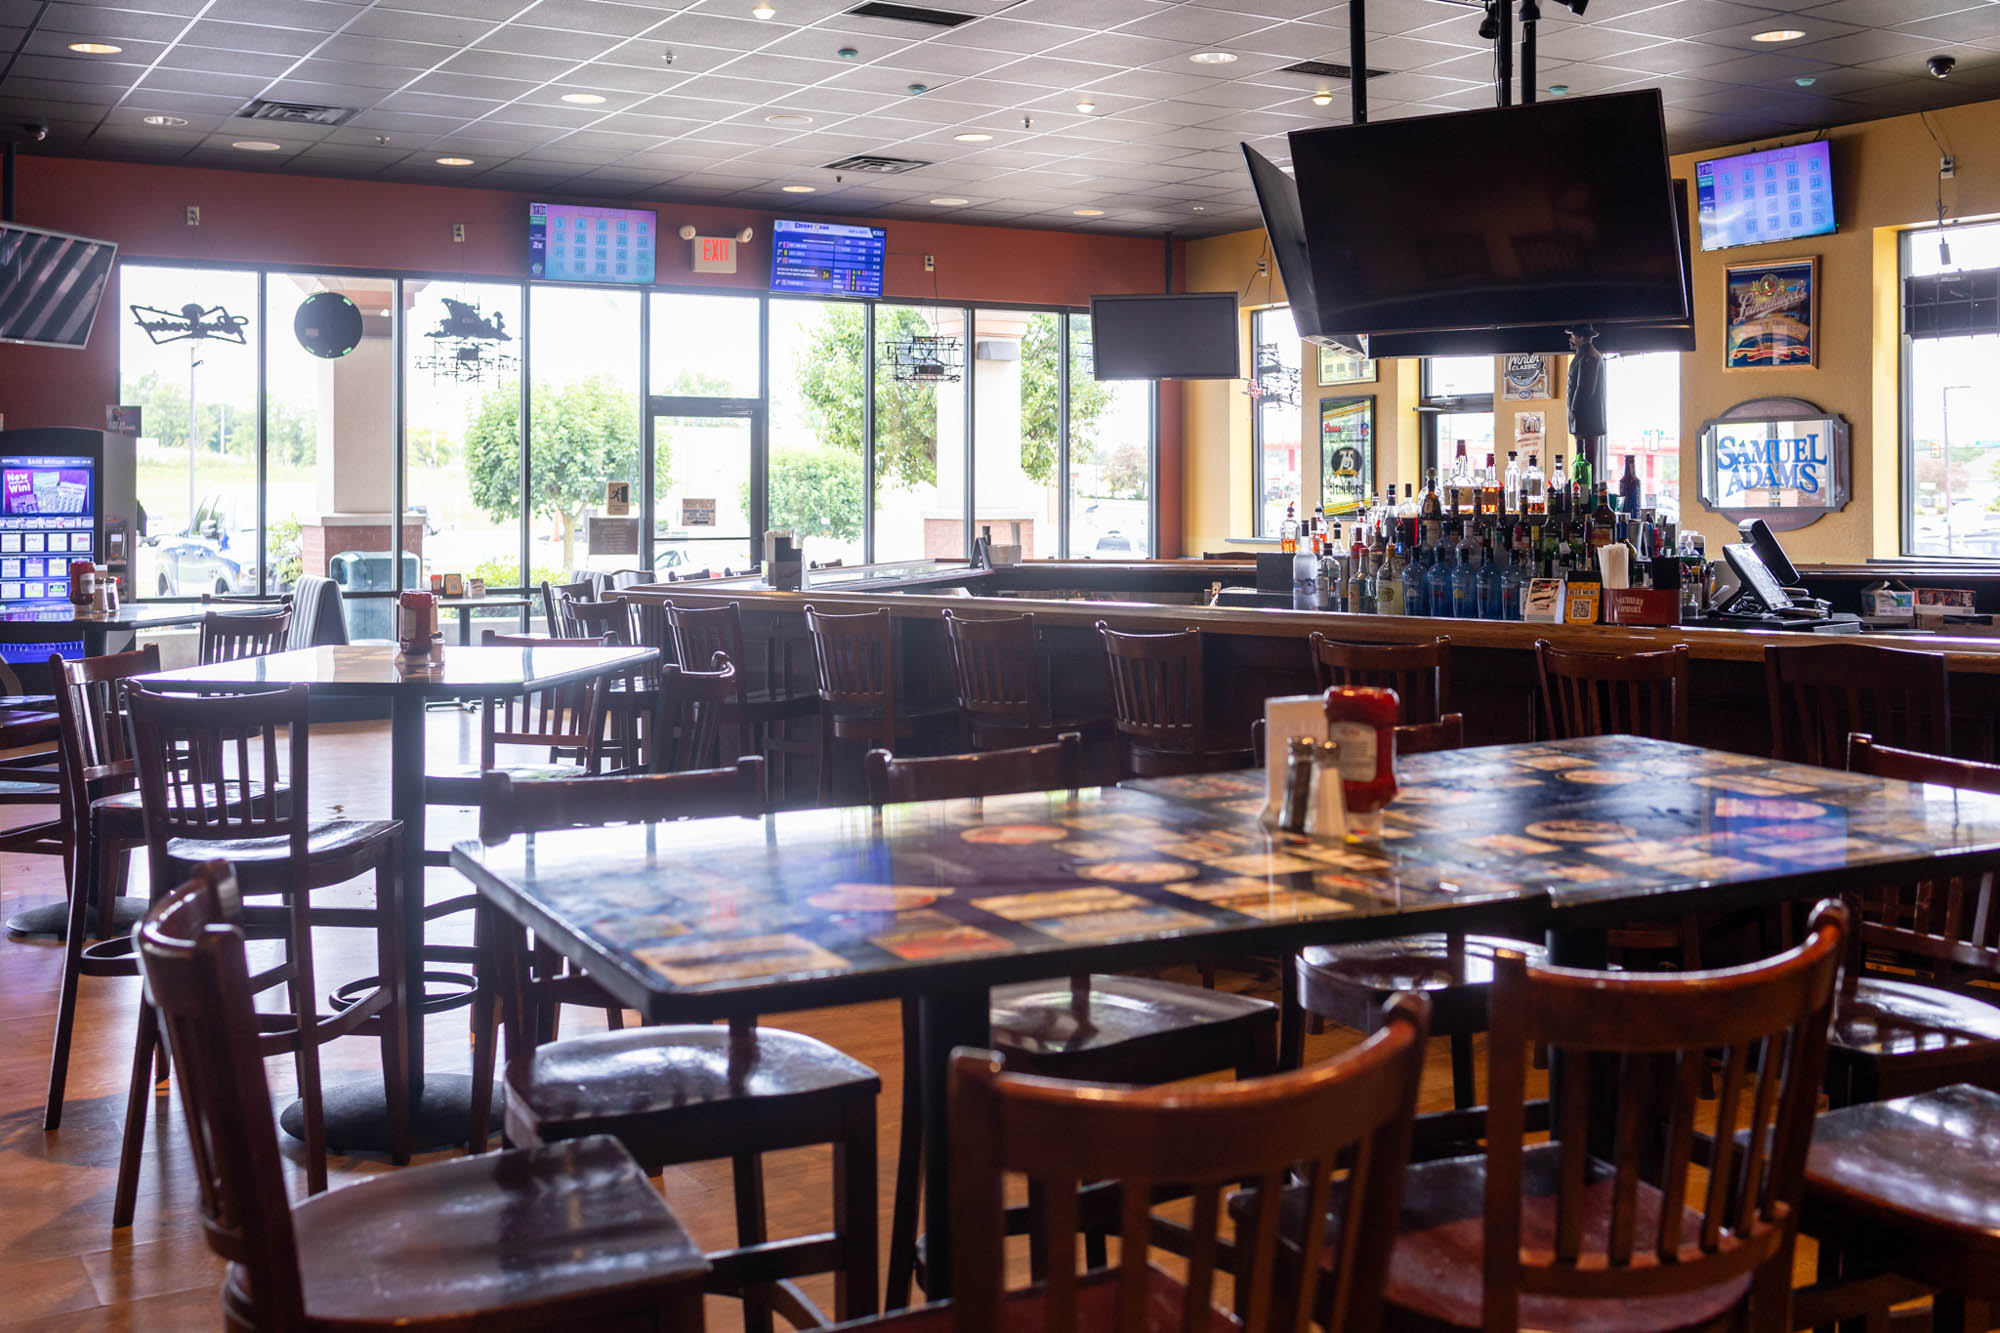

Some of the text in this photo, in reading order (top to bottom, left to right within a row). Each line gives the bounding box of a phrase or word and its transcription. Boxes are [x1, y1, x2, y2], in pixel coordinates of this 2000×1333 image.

[703, 239, 730, 262] EXIT
[1718, 433, 1828, 470] SAMUEL
[1725, 463, 1819, 497] ADAMS
